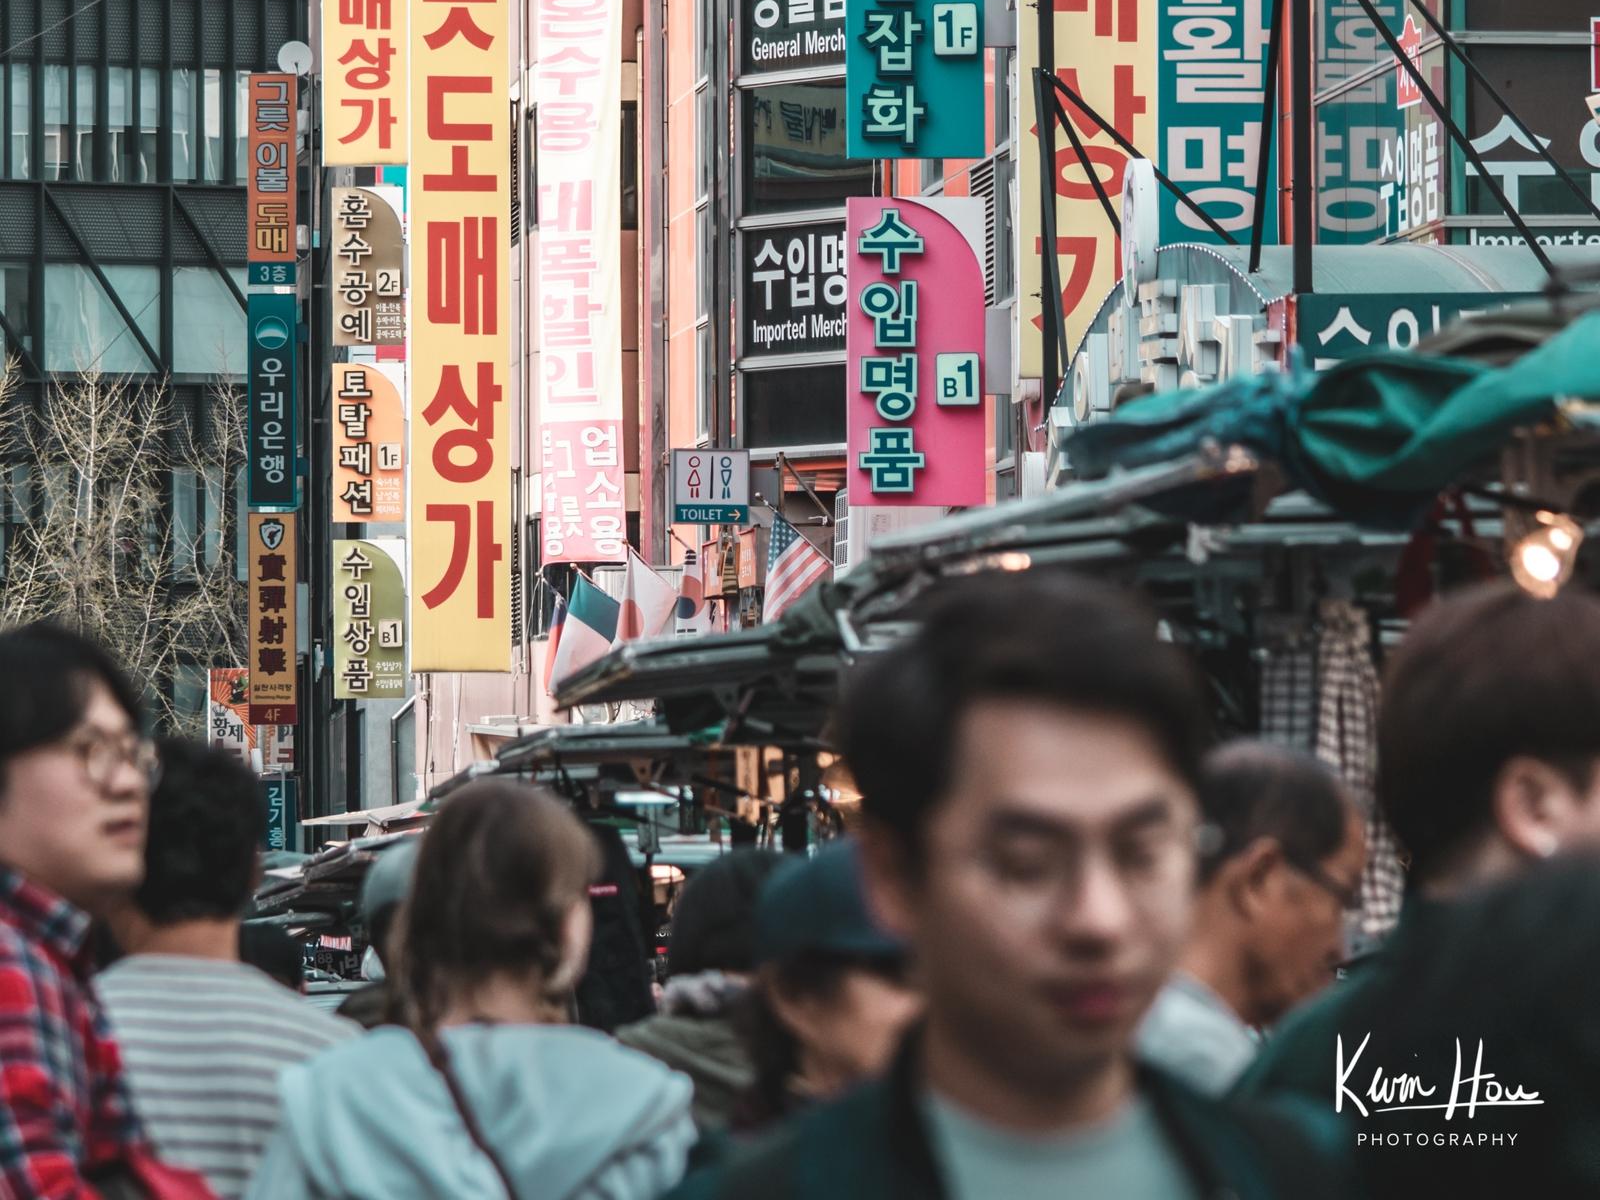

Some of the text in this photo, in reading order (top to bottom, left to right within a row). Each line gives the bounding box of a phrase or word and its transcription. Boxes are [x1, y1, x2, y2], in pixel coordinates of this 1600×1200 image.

[751, 33, 800, 61] General
[939, 10, 973, 50] 1F
[256, 81, 289, 254] 그릇 이불 도매
[1380, 120, 1439, 237] 수입명품
[260, 266, 287, 282] 3층
[338, 194, 373, 343] 혼수공예
[378, 271, 399, 293] 2F
[752, 231, 848, 310] 수입명
[753, 315, 807, 349] Imported
[858, 208, 925, 493] 수입명품
[943, 358, 975, 398] B1
[258, 356, 286, 485] 우리은행
[338, 370, 373, 515] 토탈패션
[380, 446, 399, 467] 1F
[555, 439, 585, 538] 그릇
[581, 425, 625, 556] 업소용
[680, 508, 723, 520] TOILET
[341, 547, 375, 693] 수입상품
[382, 623, 398, 644] B1
[213, 717, 244, 743] 황제
[264, 708, 281, 722] 4F
